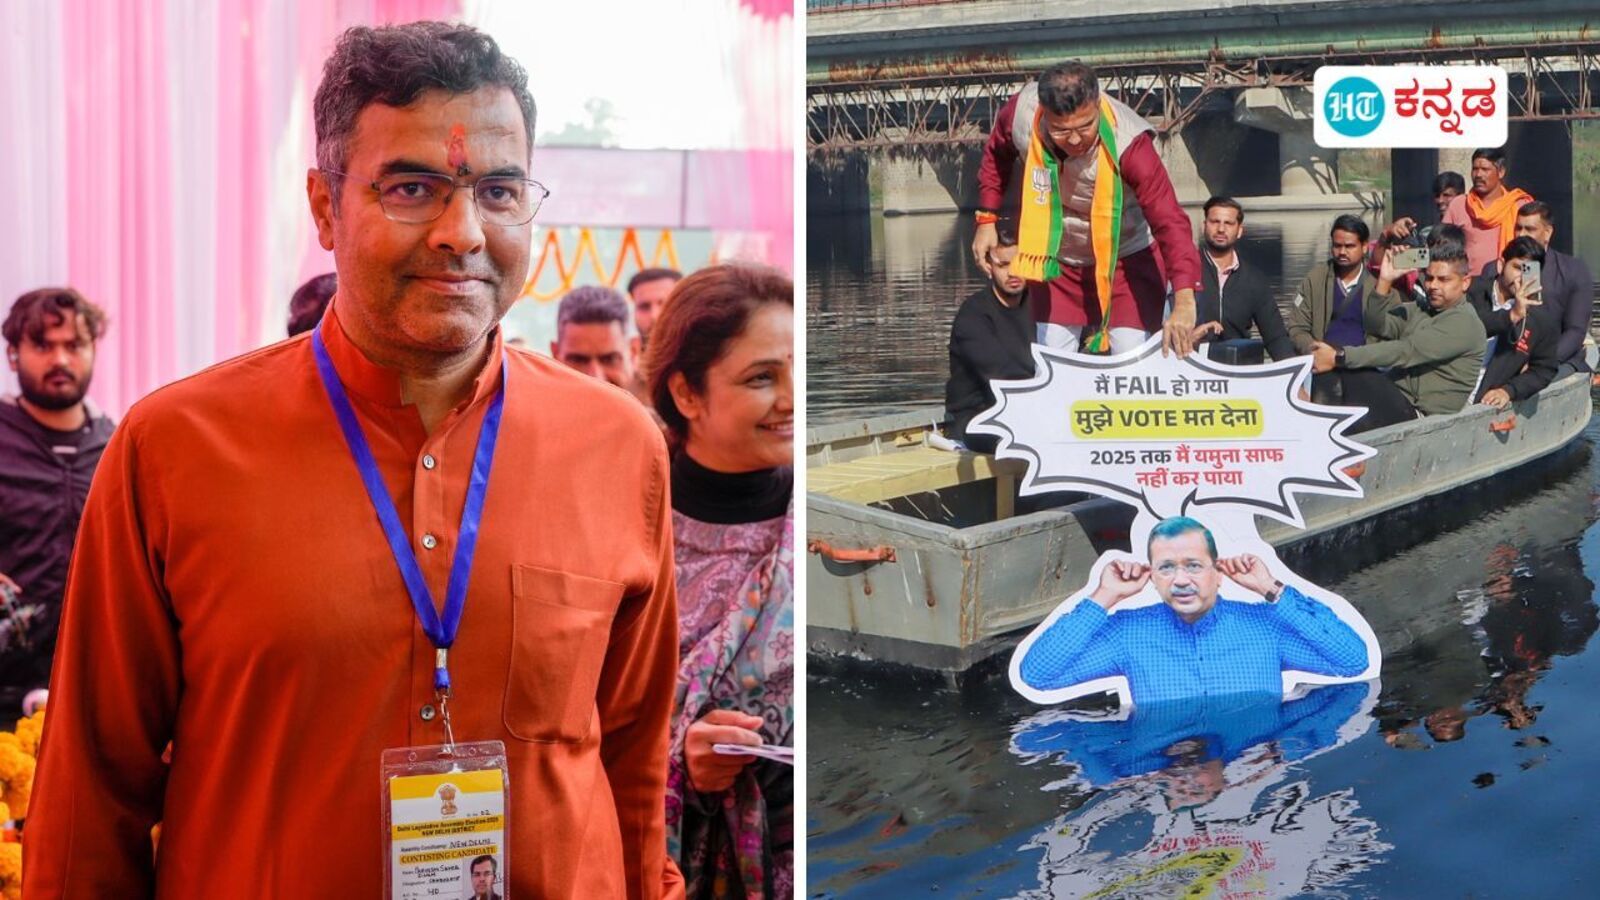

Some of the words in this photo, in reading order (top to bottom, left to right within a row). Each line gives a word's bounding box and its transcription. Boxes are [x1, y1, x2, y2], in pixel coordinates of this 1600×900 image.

[1094, 374, 1109, 395] मैं
[1115, 376, 1167, 395] FAIL
[1171, 375, 1190, 396] हो
[1193, 379, 1229, 394] गया
[1074, 404, 1114, 433] मुझे
[1119, 409, 1177, 427] VOTE
[1183, 408, 1214, 426] मत
[1220, 403, 1258, 428] देना
[1089, 450, 1136, 465] 2025
[1141, 449, 1171, 464] तक
[1175, 444, 1190, 463] मैं
[1194, 447, 1240, 469] यमुना
[1244, 447, 1284, 463] साफ
[1136, 468, 1169, 489] नहीं
[1172, 471, 1200, 486] कर
[1203, 470, 1243, 486] पाया
[401, 851, 451, 864] CONTESTING
[452, 847, 495, 858] CANDIDATE
